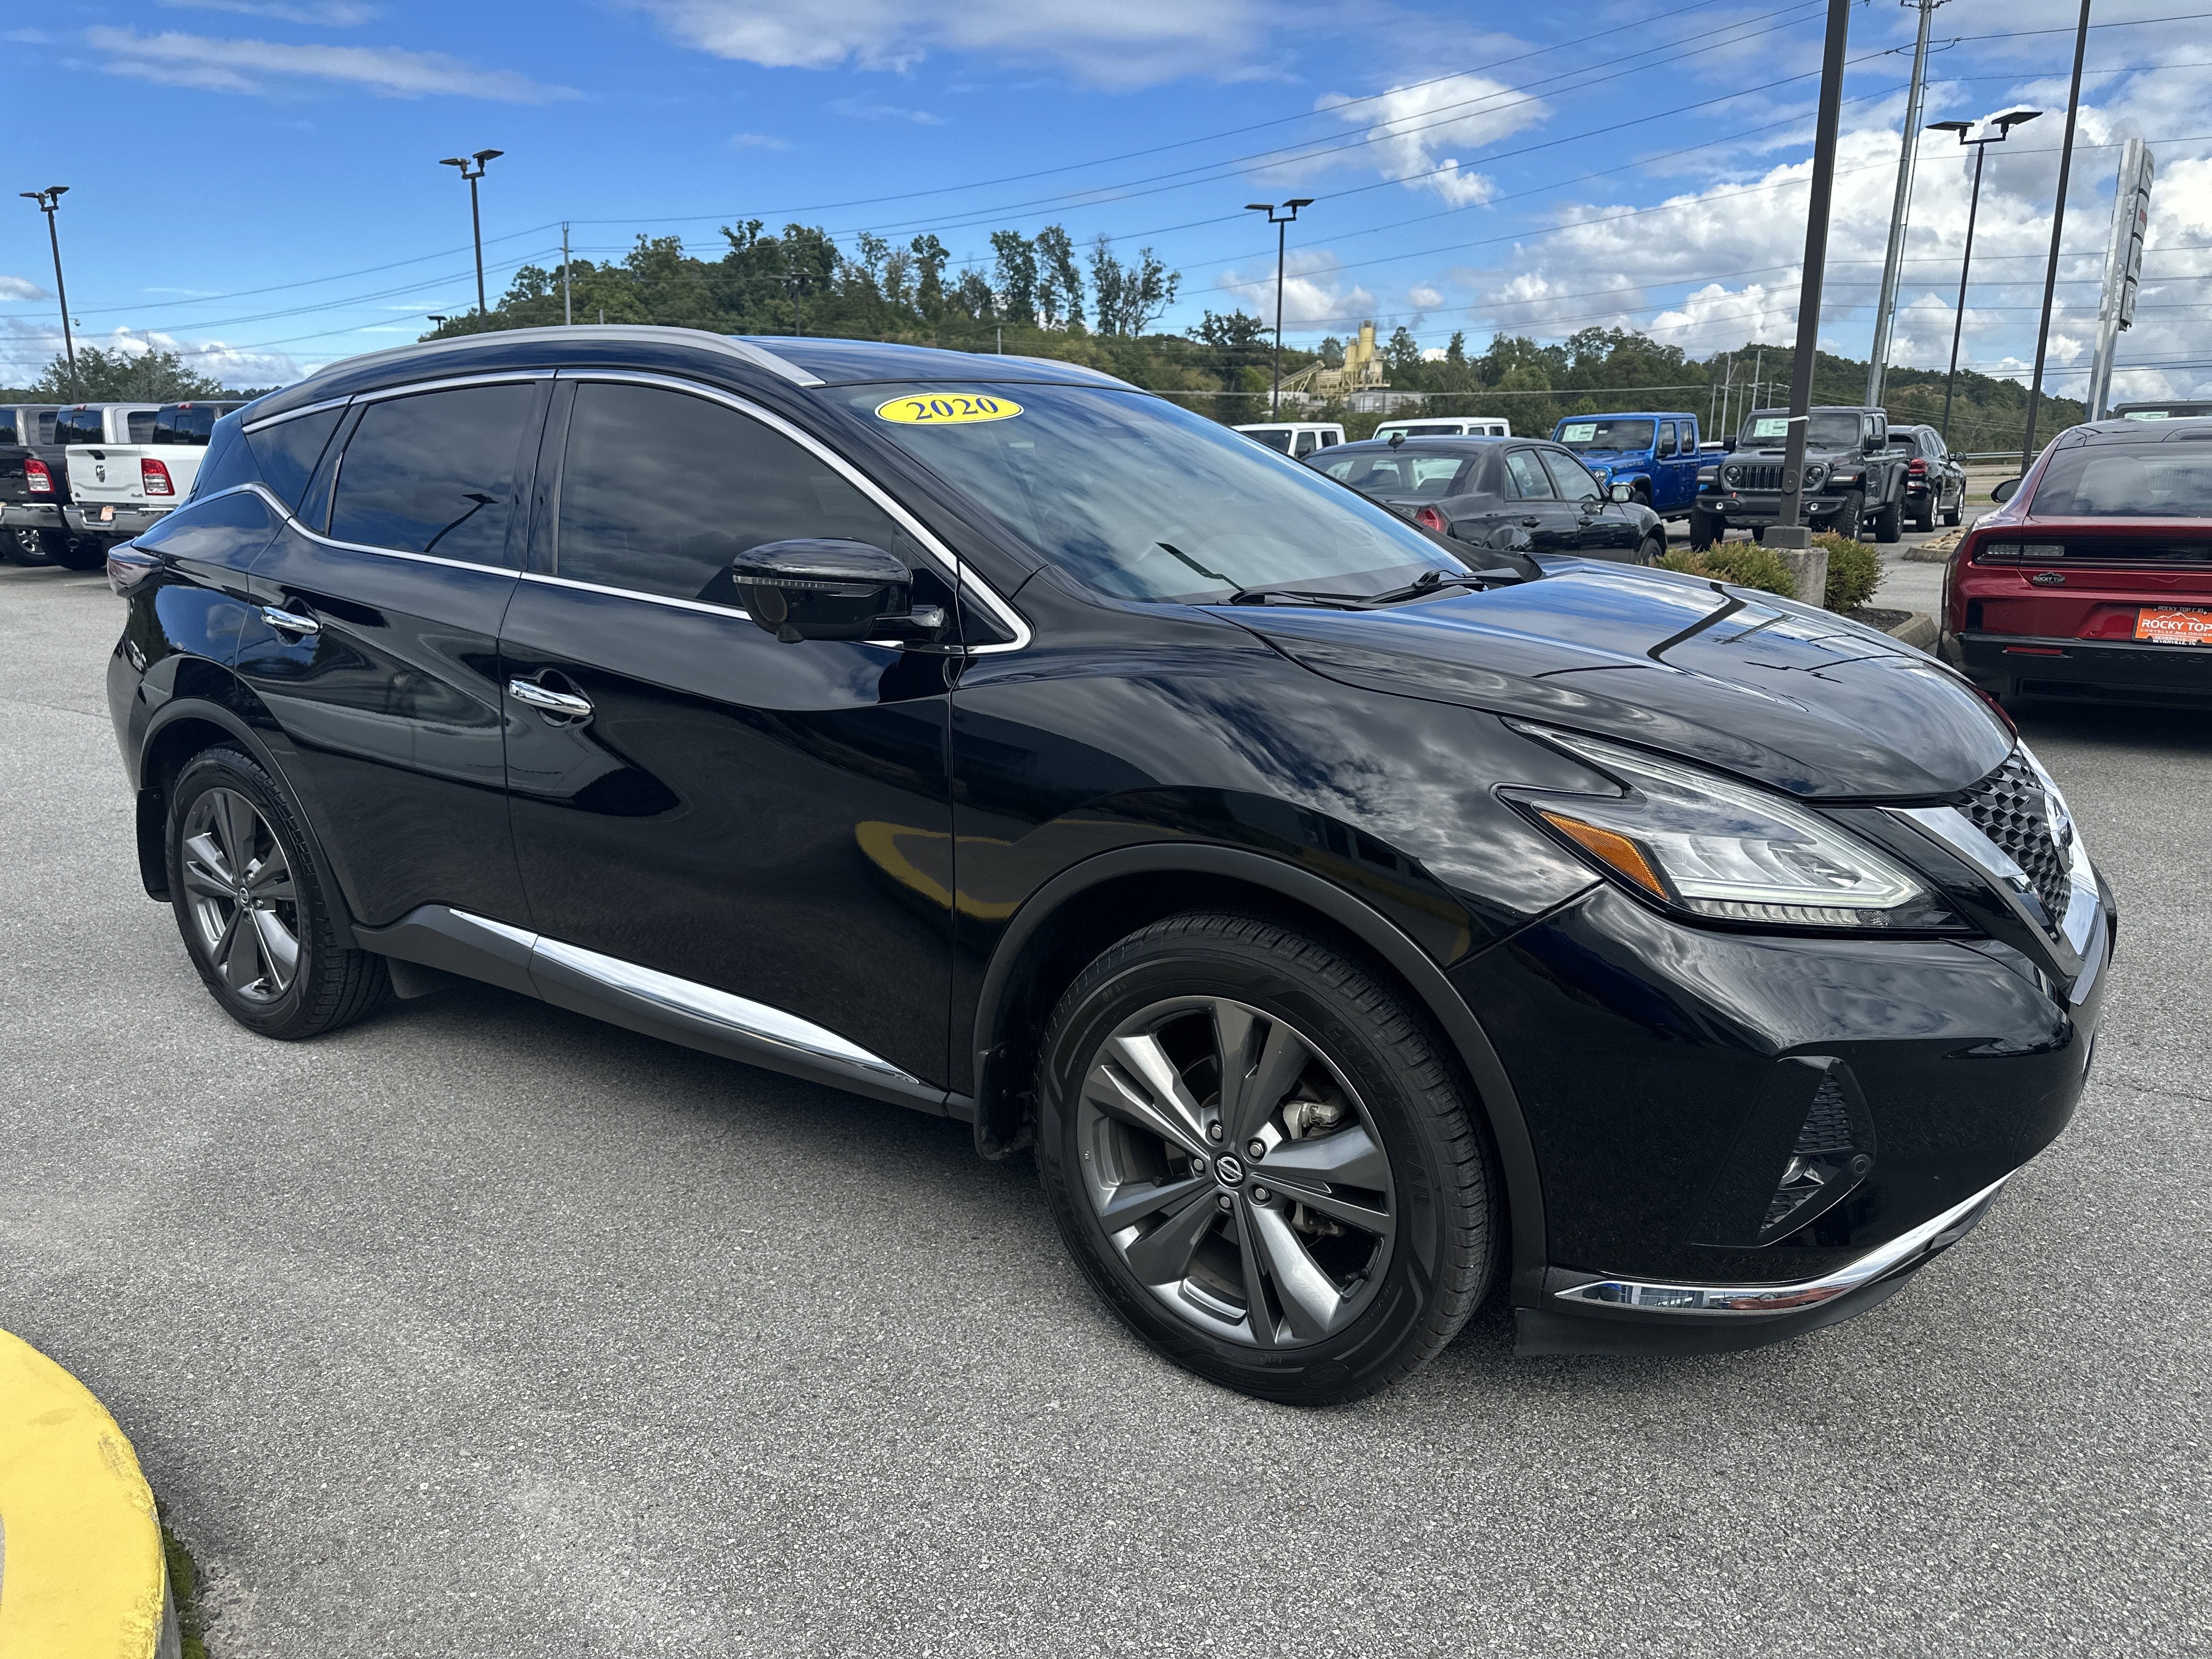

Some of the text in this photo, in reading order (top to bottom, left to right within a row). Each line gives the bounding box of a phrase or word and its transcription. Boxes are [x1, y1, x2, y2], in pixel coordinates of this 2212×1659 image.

[906, 397, 998, 420] 2020
[2141, 619, 2212, 632] ROCKY TOP
